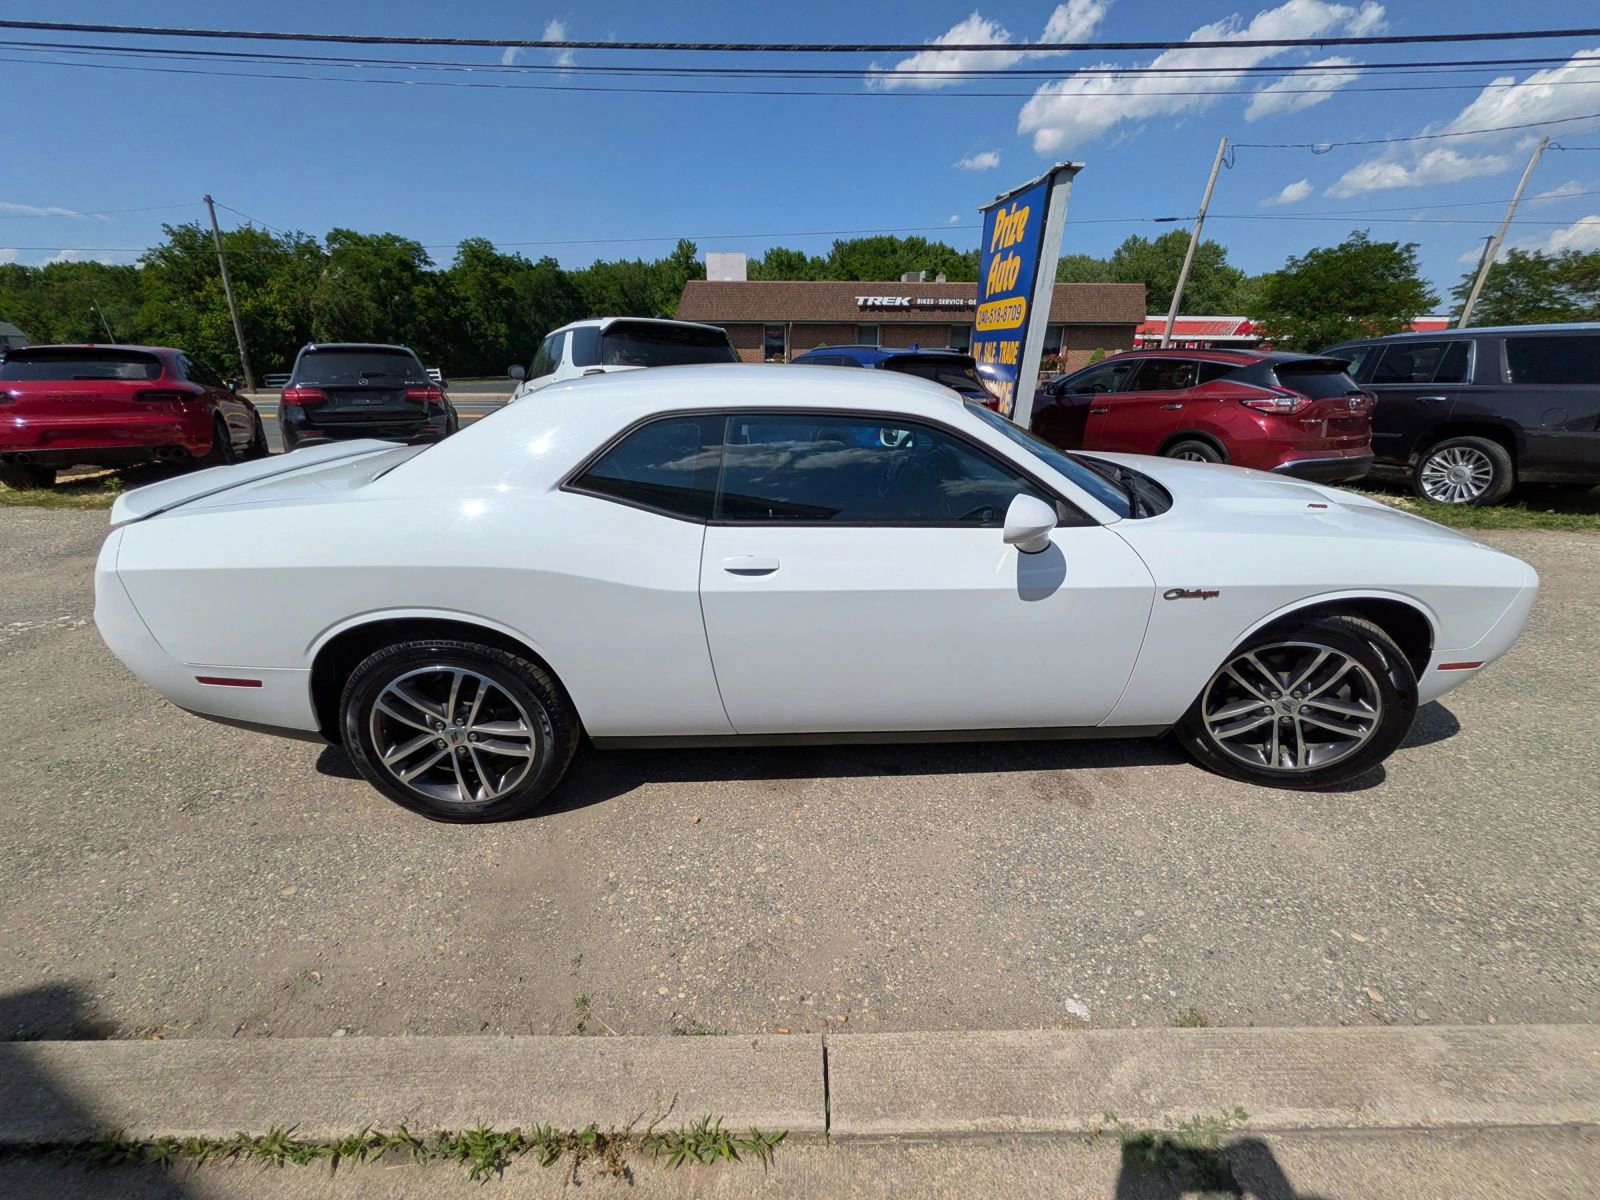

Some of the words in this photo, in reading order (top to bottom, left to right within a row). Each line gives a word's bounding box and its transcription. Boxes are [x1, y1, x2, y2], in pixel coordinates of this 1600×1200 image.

[990, 202, 1030, 254] Prize
[985, 249, 1022, 299] Auto
[855, 296, 912, 306] TREK
[977, 303, 1022, 326] 240-518-8709
[983, 341, 996, 363] SALE
[998, 341, 1020, 365] TRADE
